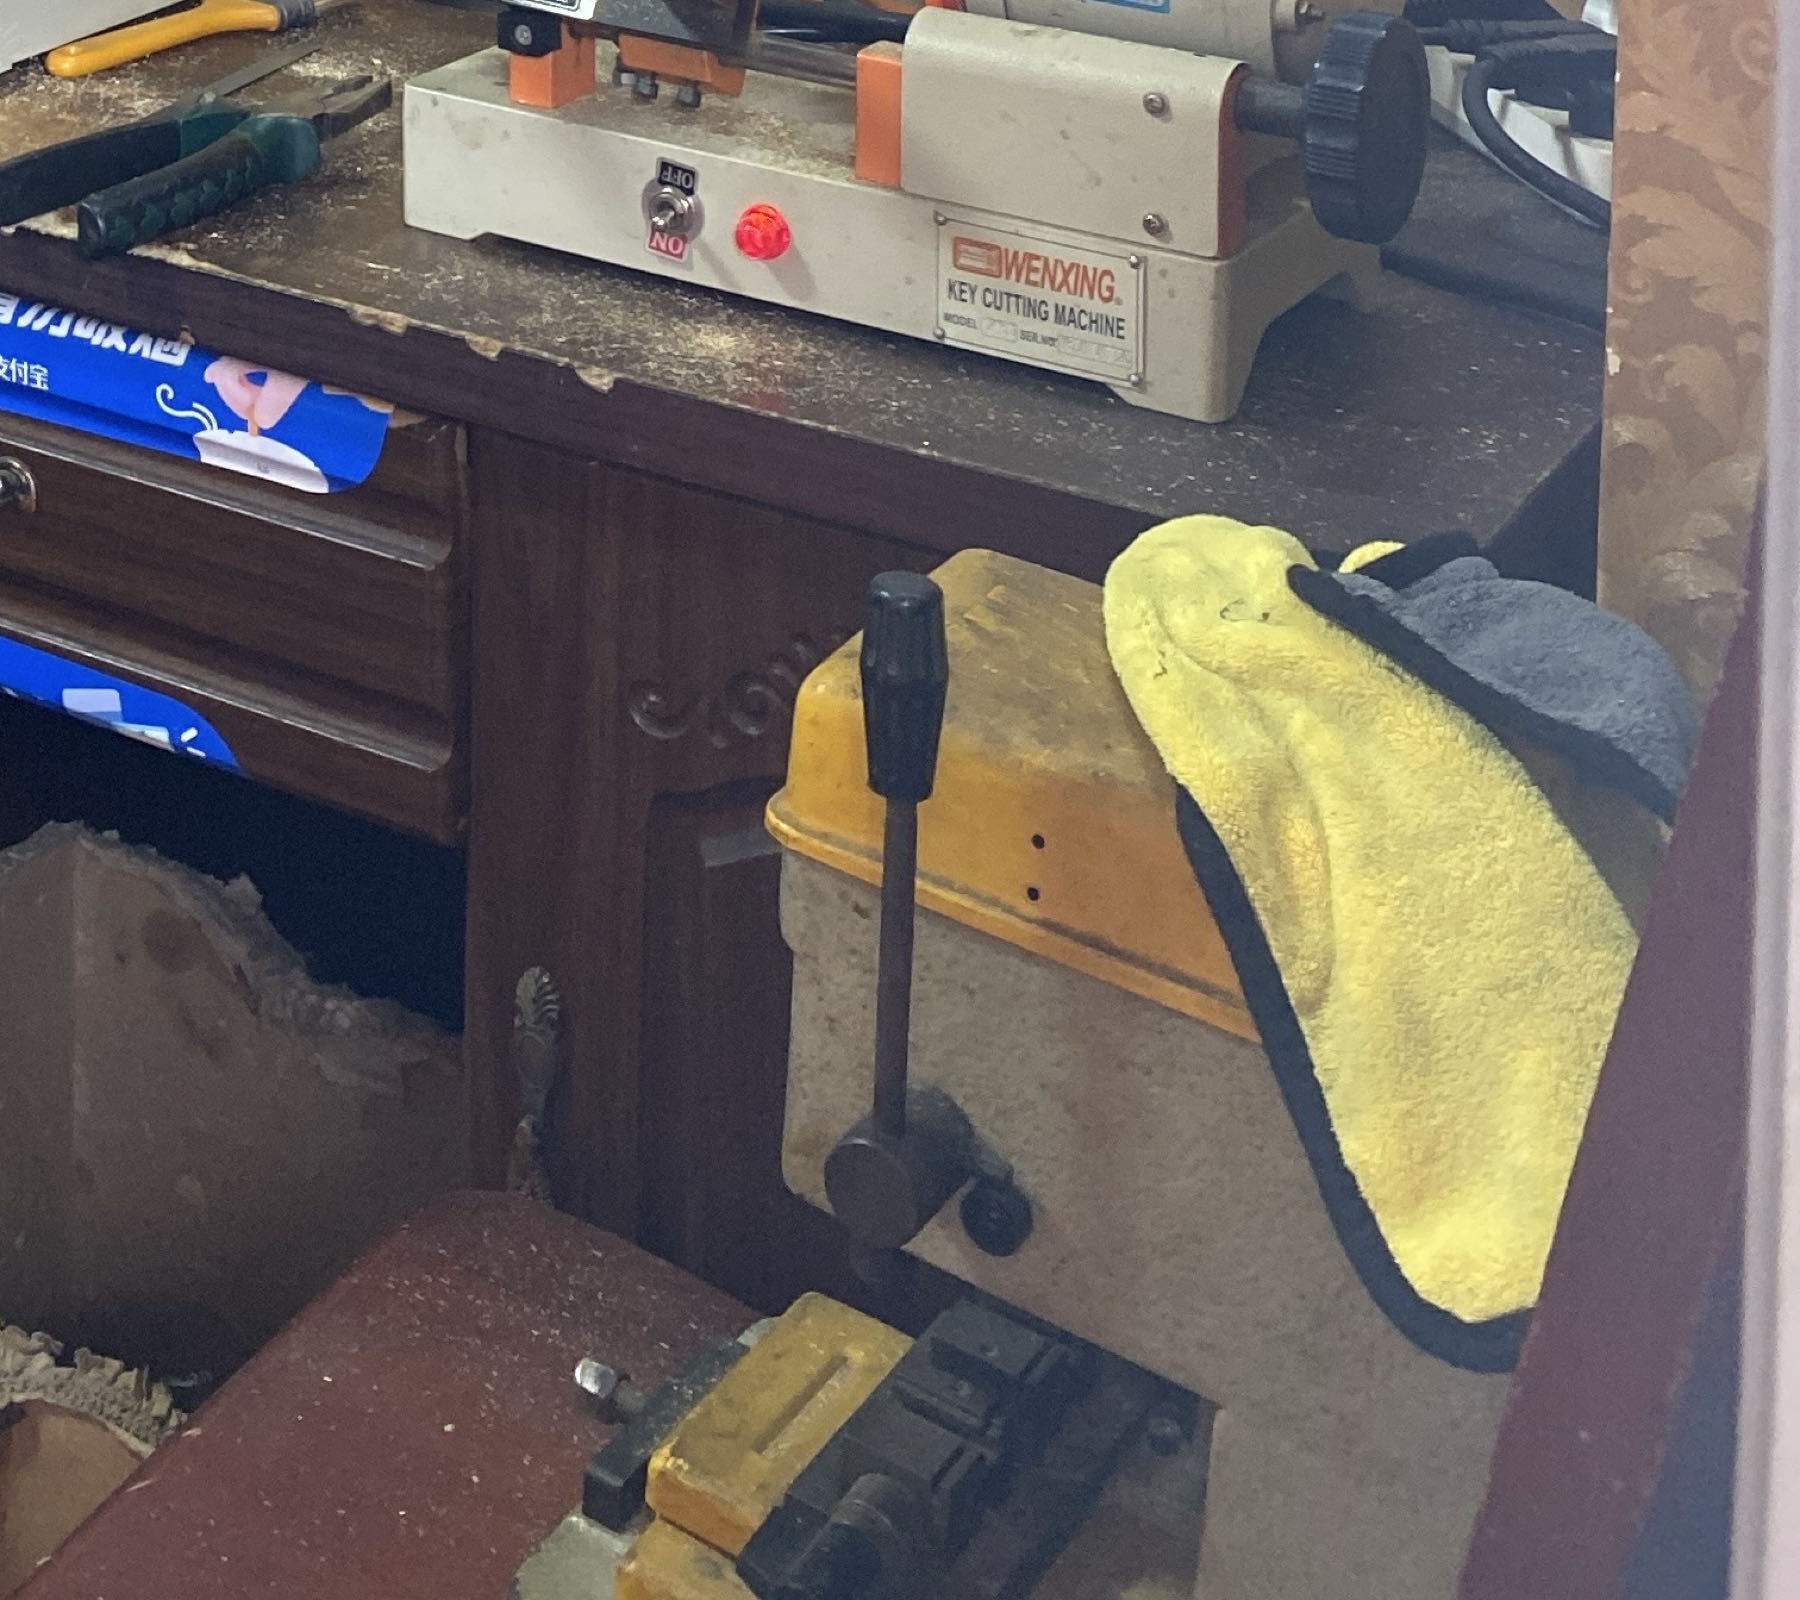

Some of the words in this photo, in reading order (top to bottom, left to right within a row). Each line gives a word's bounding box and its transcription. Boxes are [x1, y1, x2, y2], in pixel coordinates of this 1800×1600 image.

[661, 166, 694, 189] OFF
[650, 231, 683, 255] ON
[1003, 246, 1116, 304] WENXING
[947, 279, 978, 305] KEY
[982, 287, 1050, 321] CUTTING
[1054, 303, 1126, 340] MACHINE
